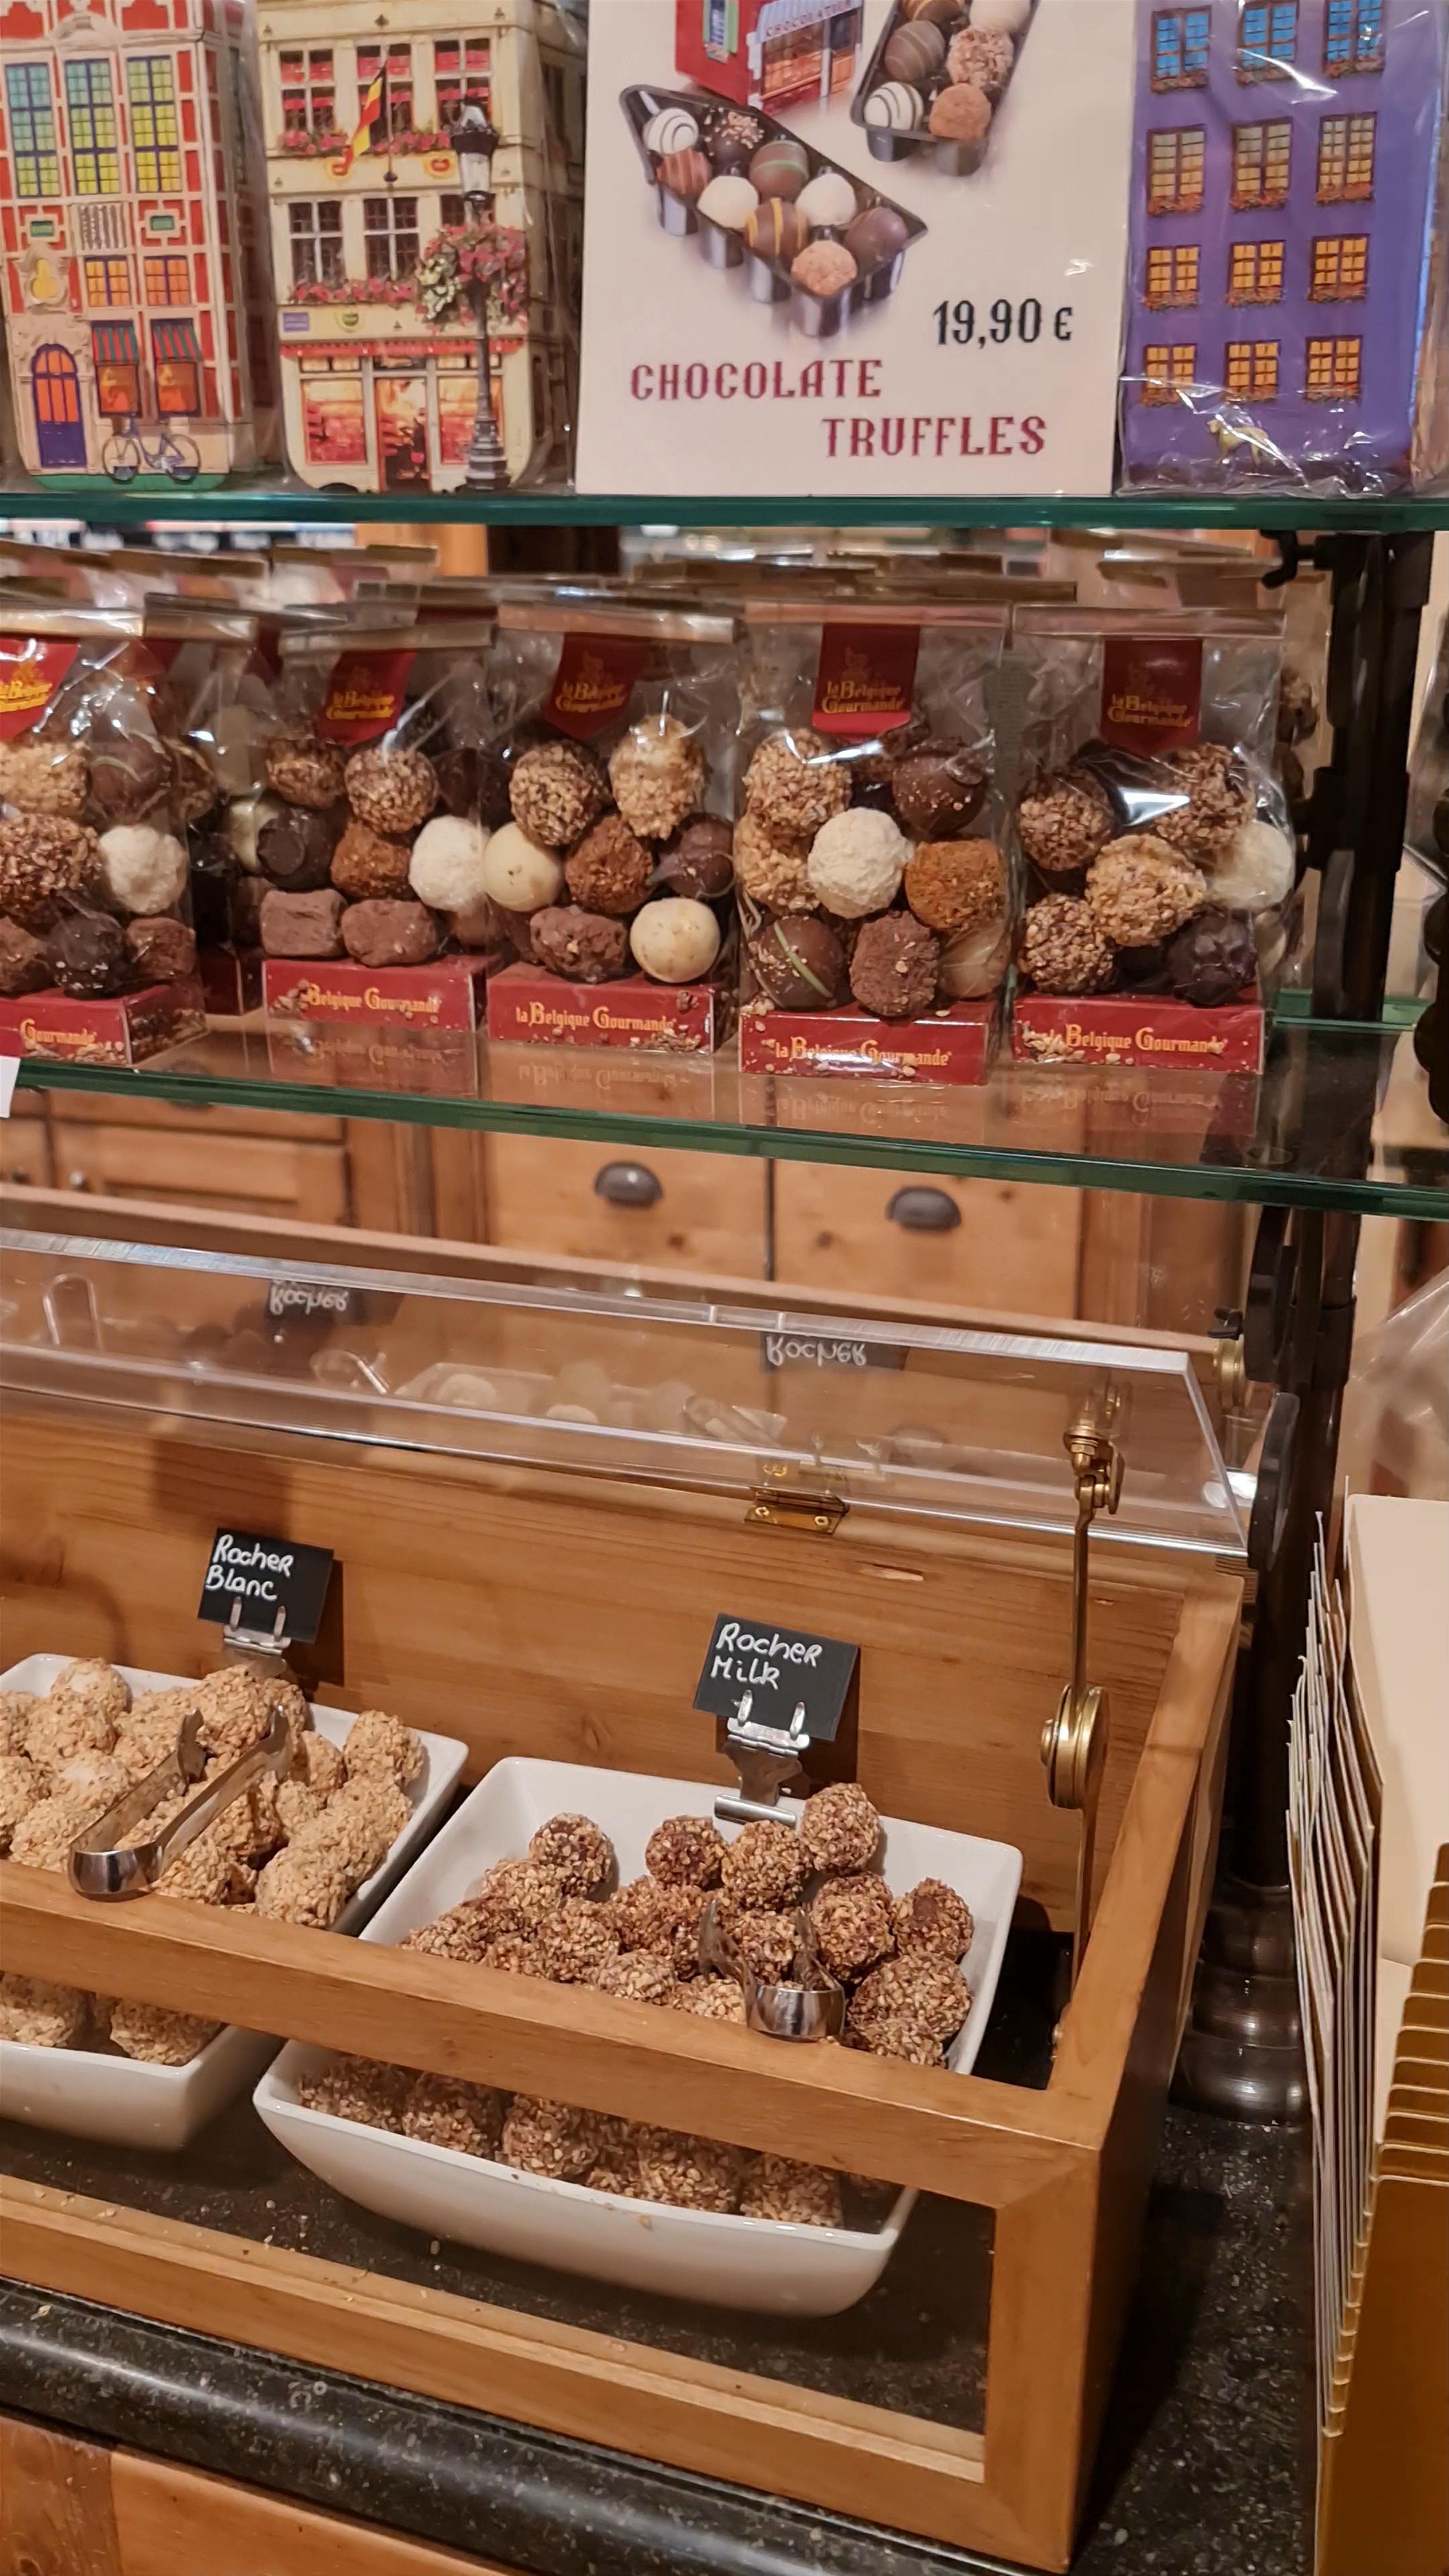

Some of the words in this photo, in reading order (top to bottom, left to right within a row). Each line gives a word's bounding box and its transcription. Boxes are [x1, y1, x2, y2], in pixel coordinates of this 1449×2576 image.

[933, 298, 1042, 349] 19,90
[1055, 307, 1072, 341] €
[631, 360, 883, 401] CHOCOLATE
[823, 416, 1047, 457] TRUFFLES
[515, 1007, 527, 1023] la
[528, 1001, 590, 1030] Belgique
[775, 1042, 789, 1058] la
[1064, 1024, 1131, 1053] Belgique
[205, 1565, 278, 1601] Blanc
